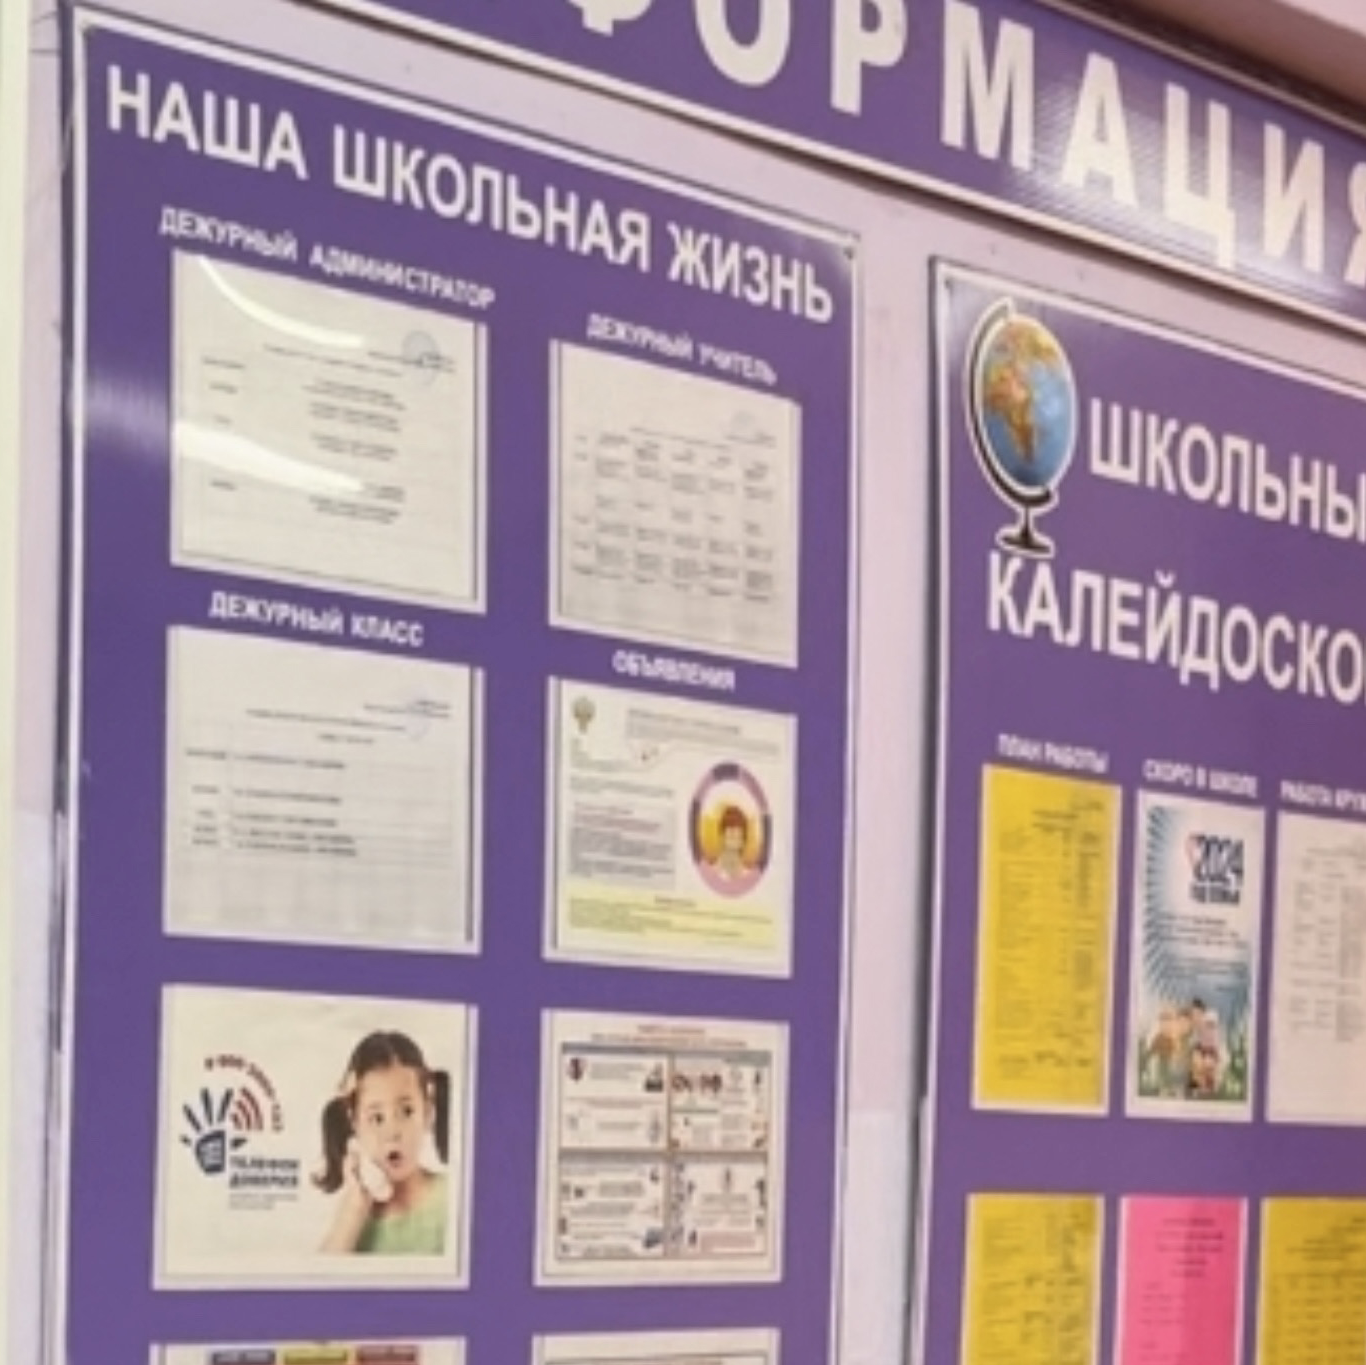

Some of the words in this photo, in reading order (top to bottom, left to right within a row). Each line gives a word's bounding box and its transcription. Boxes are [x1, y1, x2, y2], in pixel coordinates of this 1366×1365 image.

[107, 63, 310, 180] НАША
[334, 122, 651, 273] ШКОЛЬНАЯ
[666, 220, 834, 324] ЖИЗНЬ
[159, 205, 298, 261] ДЕЖУРНЫЙ
[309, 242, 496, 311] АДМИНИСТРАТОР
[586, 312, 693, 361] ДЕЖУРНЫЙ
[699, 342, 778, 387] УЧИТЕЛЬ
[208, 590, 344, 636] ДЕЖУРНЫЙ
[350, 614, 424, 648] КЛАСС
[611, 649, 736, 693] ОБЪЯВЛЕНИЯ
[997, 732, 1043, 762] ПЛАН
[1044, 742, 1110, 775] РАБОТЫ
[1142, 758, 1193, 786] СКОРО
[1195, 766, 1207, 790] В
[1208, 769, 1258, 798] ШКОЛЕ
[1280, 780, 1332, 805] РАБОТА
